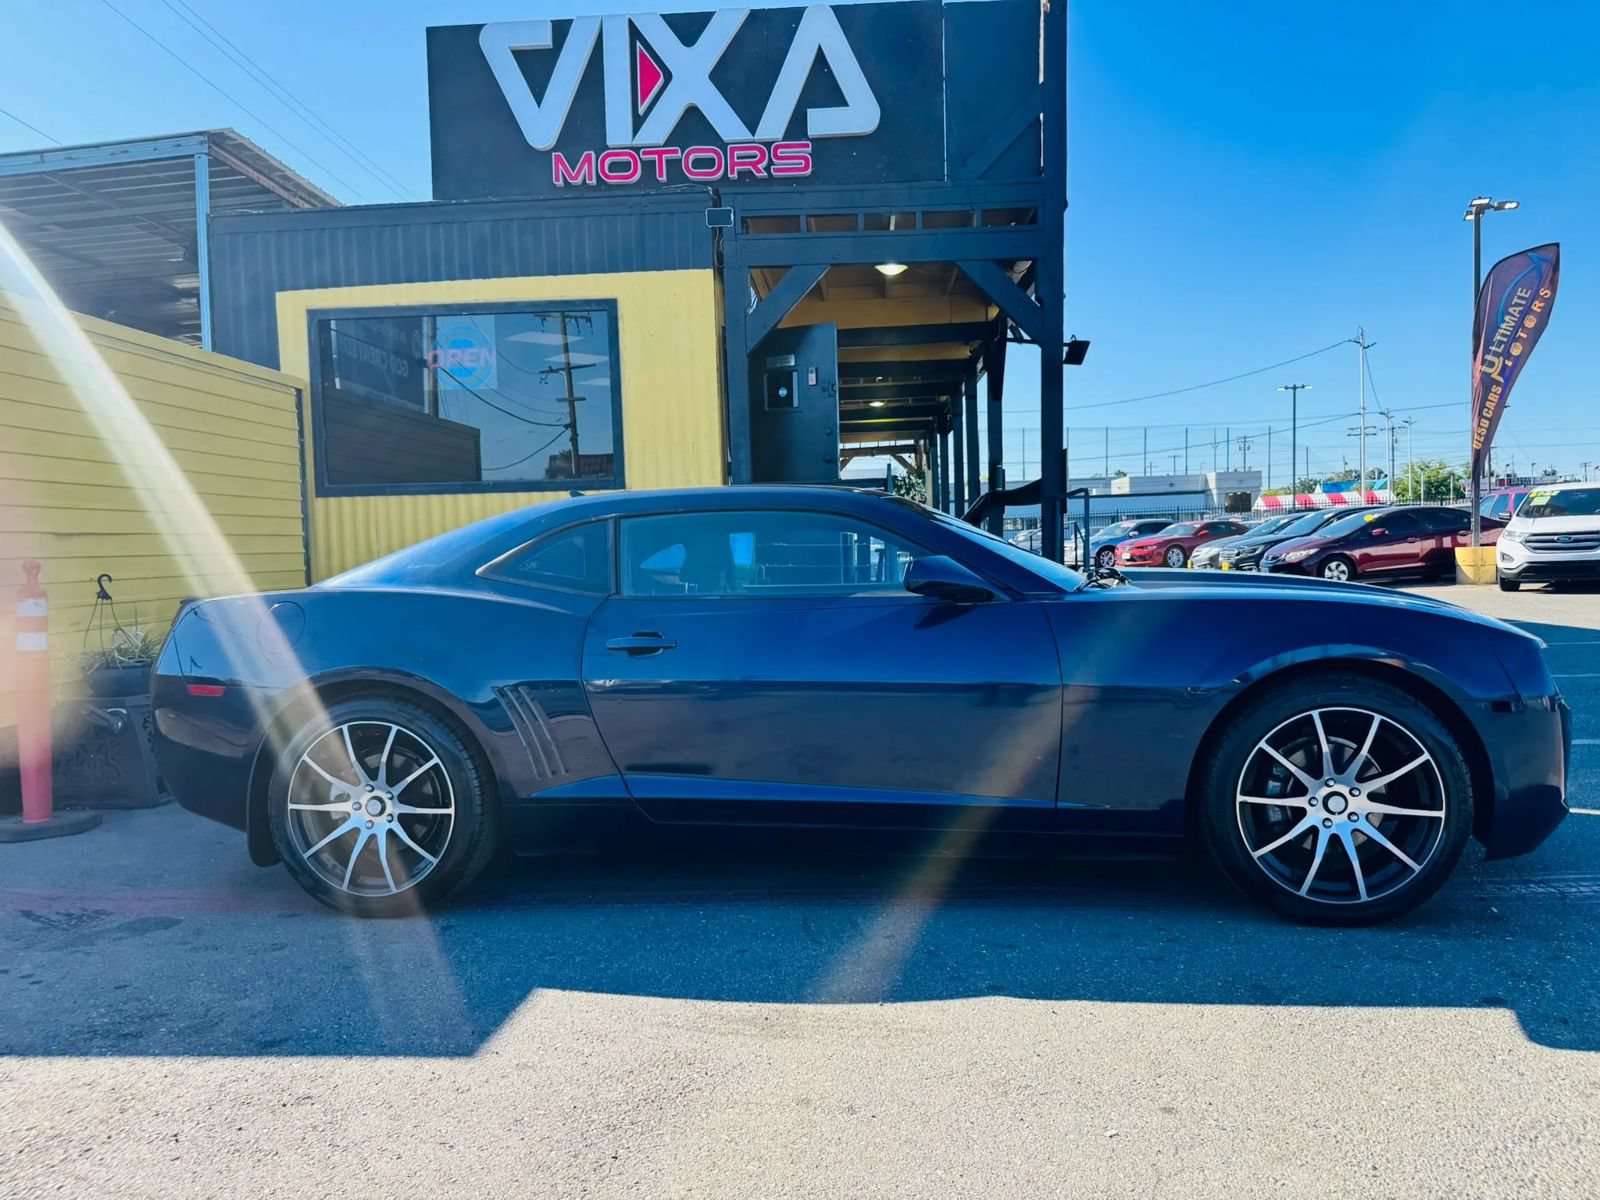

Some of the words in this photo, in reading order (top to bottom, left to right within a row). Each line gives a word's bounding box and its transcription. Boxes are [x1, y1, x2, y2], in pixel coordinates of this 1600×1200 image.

[479, 5, 881, 151] VIXA
[551, 141, 813, 187] MOTORS
[1482, 287, 1532, 375] ULTIMATE
[427, 348, 497, 369] OPEN
[1482, 384, 1502, 418] CARS
